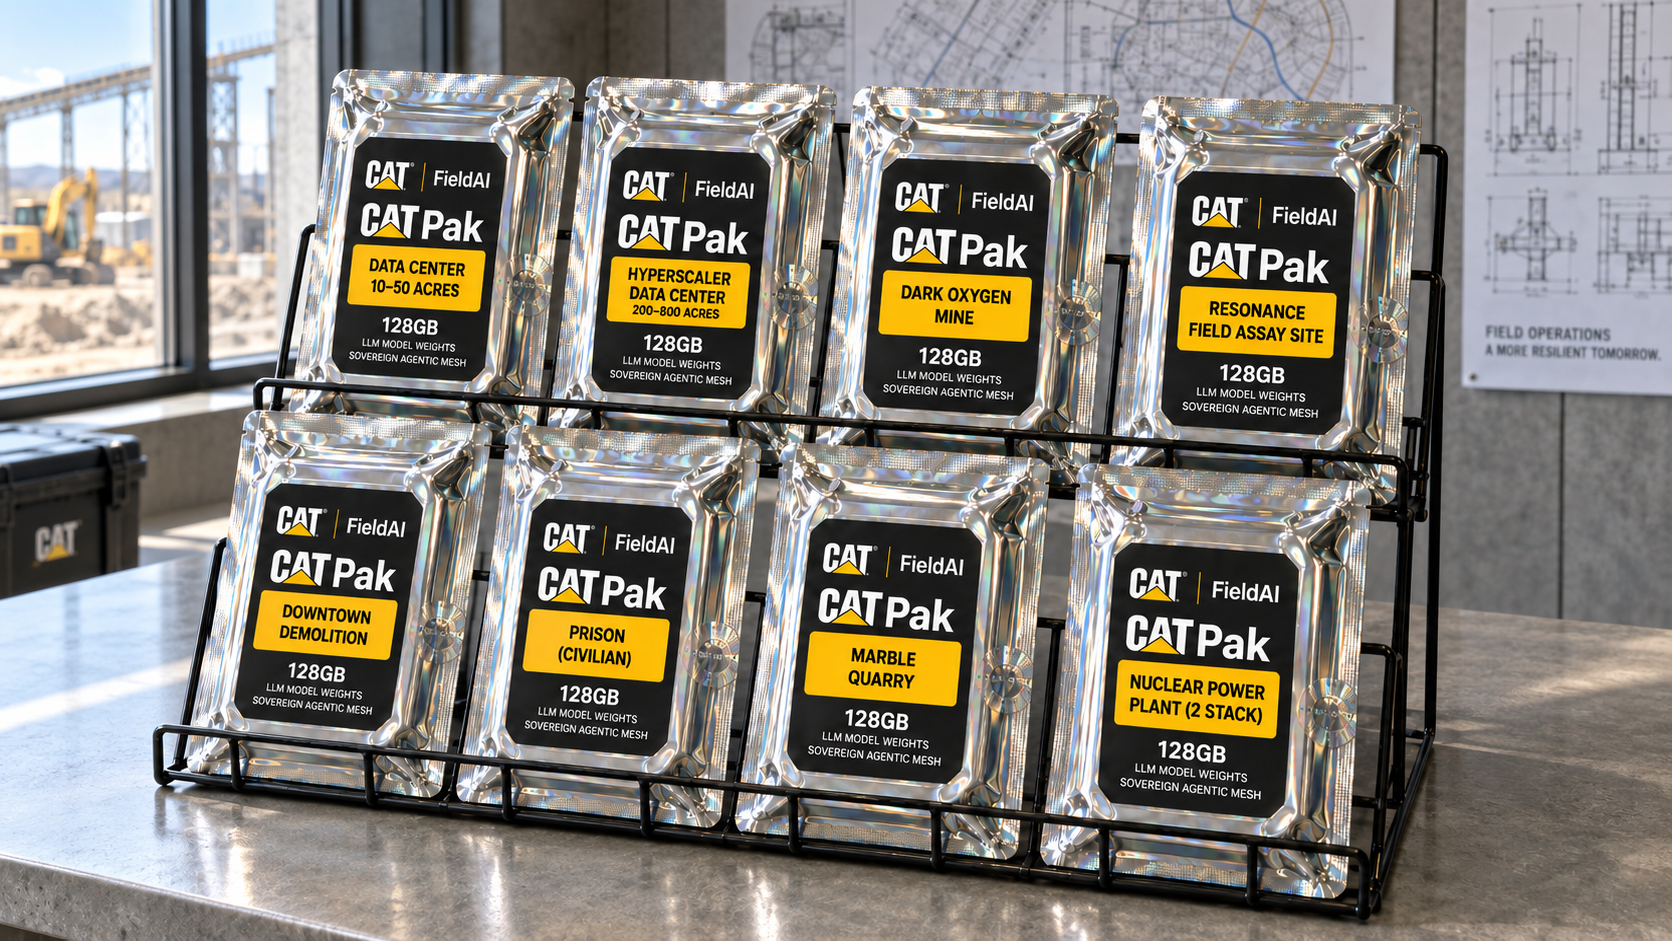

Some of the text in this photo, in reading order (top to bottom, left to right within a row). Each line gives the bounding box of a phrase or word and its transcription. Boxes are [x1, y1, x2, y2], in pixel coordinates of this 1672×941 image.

[365, 160, 491, 190] CAT FieldAI
[623, 170, 754, 201] CAT FieldAI
[895, 181, 1034, 213] CAT FieldAI
[1192, 195, 1337, 228] CAT FieldAI
[360, 202, 484, 243] CAT Pak
[618, 214, 749, 255] CAT Pak
[892, 226, 1028, 269] CAT Pak
[369, 258, 465, 277] DATA CENTER
[1188, 241, 1329, 284] CAT Pak
[628, 267, 731, 286] HYPERSCALER
[413, 282, 459, 297] ACRES
[630, 286, 725, 304] DATA CENTER
[901, 285, 1011, 304] DARK OXYGEN
[683, 307, 719, 319] ACRES
[935, 309, 974, 325] MINE
[1210, 301, 1305, 320] RESONANCE
[382, 317, 438, 335] 128GB
[1189, 322, 1324, 344] FIELD ASSAY SITE
[1485, 325, 1611, 341] FIELD OPERATIONS
[362, 338, 456, 352] LLM MODEL WEIGHTS
[644, 334, 703, 353] 128GB
[1485, 344, 1662, 361] A MORE RESILIENT TOMORROW.
[349, 351, 466, 367] SOVEREIGN AGENTIC MESH
[623, 356, 721, 371] LLM MODEL WEIGHTS
[919, 347, 982, 367] 128GB
[610, 369, 732, 385] SOVEREIGN AGENTIC MESH
[897, 370, 1002, 385] LLM MODEL WEIGHTS
[1220, 364, 1285, 384] 128GB
[883, 384, 1014, 400] SOVEREIGN AGENTIC MESH
[1196, 387, 1306, 403] LLM MODEL WEIGHTS
[1182, 401, 1319, 418] SOVEREIGN AGENTIC MESH
[276, 505, 406, 538] CAT FieldAI
[35, 520, 79, 563] CAT
[543, 522, 675, 554] CAT FieldAI
[822, 542, 964, 576] CAT FieldAI
[270, 549, 396, 592] CAT Pak
[538, 566, 667, 610] CAT Pak
[1129, 567, 1280, 603] CAT FieldAI
[282, 604, 371, 624] DOWNTOWN
[818, 588, 955, 633] CAT Pak
[280, 625, 368, 645] DEMOLITION
[569, 625, 625, 643] PRISON
[1126, 614, 1271, 662] CAT Pak
[558, 646, 631, 668] (CIVILIAN)
[851, 648, 916, 667] MARBLE
[288, 662, 346, 683] 128GB
[848, 670, 915, 689] QUARRY
[266, 683, 363, 700] LLM MODEL WEIGHTS
[560, 685, 619, 706] 128GB
[1130, 674, 1265, 700] NUCLEAR POWER
[252, 695, 373, 715] SOVEREIGN AGENTIC MESH
[1130, 697, 1262, 726] PLANT (2 STACK)
[538, 707, 637, 724] LLM MODEL WEIGHTS
[845, 709, 909, 731] 128GB
[524, 720, 648, 740] SOVEREIGN AGENTIC MESH
[822, 731, 929, 750] LLM MODEL WEIGHTS
[808, 745, 941, 766] SOVEREIGN AGENTIC MESH
[1158, 740, 1226, 763] 128GB
[1135, 763, 1248, 783] LLM MODEL WEIGHTS
[1120, 777, 1261, 800] SOVEREIGN AGENTIC MESH
